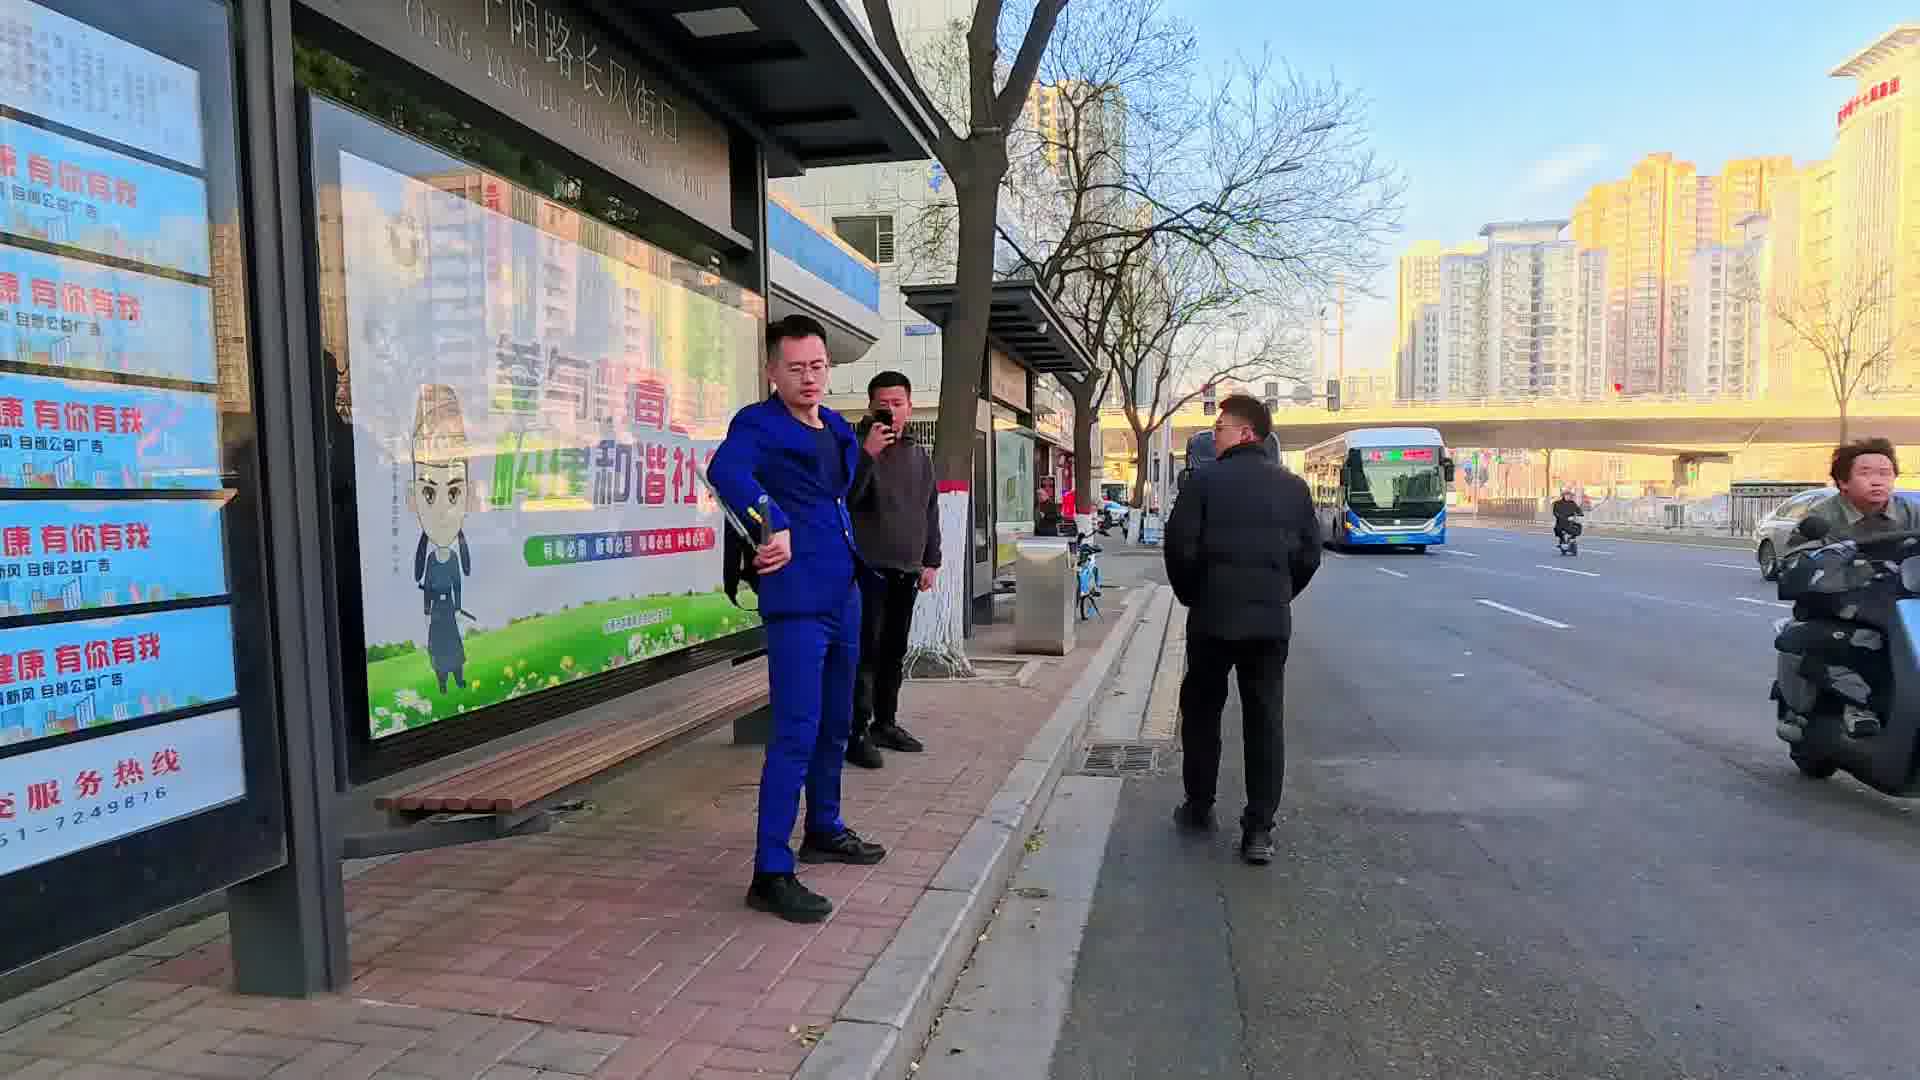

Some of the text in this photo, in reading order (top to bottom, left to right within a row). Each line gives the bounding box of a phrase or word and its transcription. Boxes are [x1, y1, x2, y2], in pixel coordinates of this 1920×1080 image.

[31, 279, 140, 321] 有你有我
[33, 400, 144, 434] 有你有我
[41, 522, 151, 555] 有你有我
[27, 558, 111, 577] 自创公益广告
[55, 632, 160, 675] 有你有我
[41, 672, 123, 698] 自创公益广告
